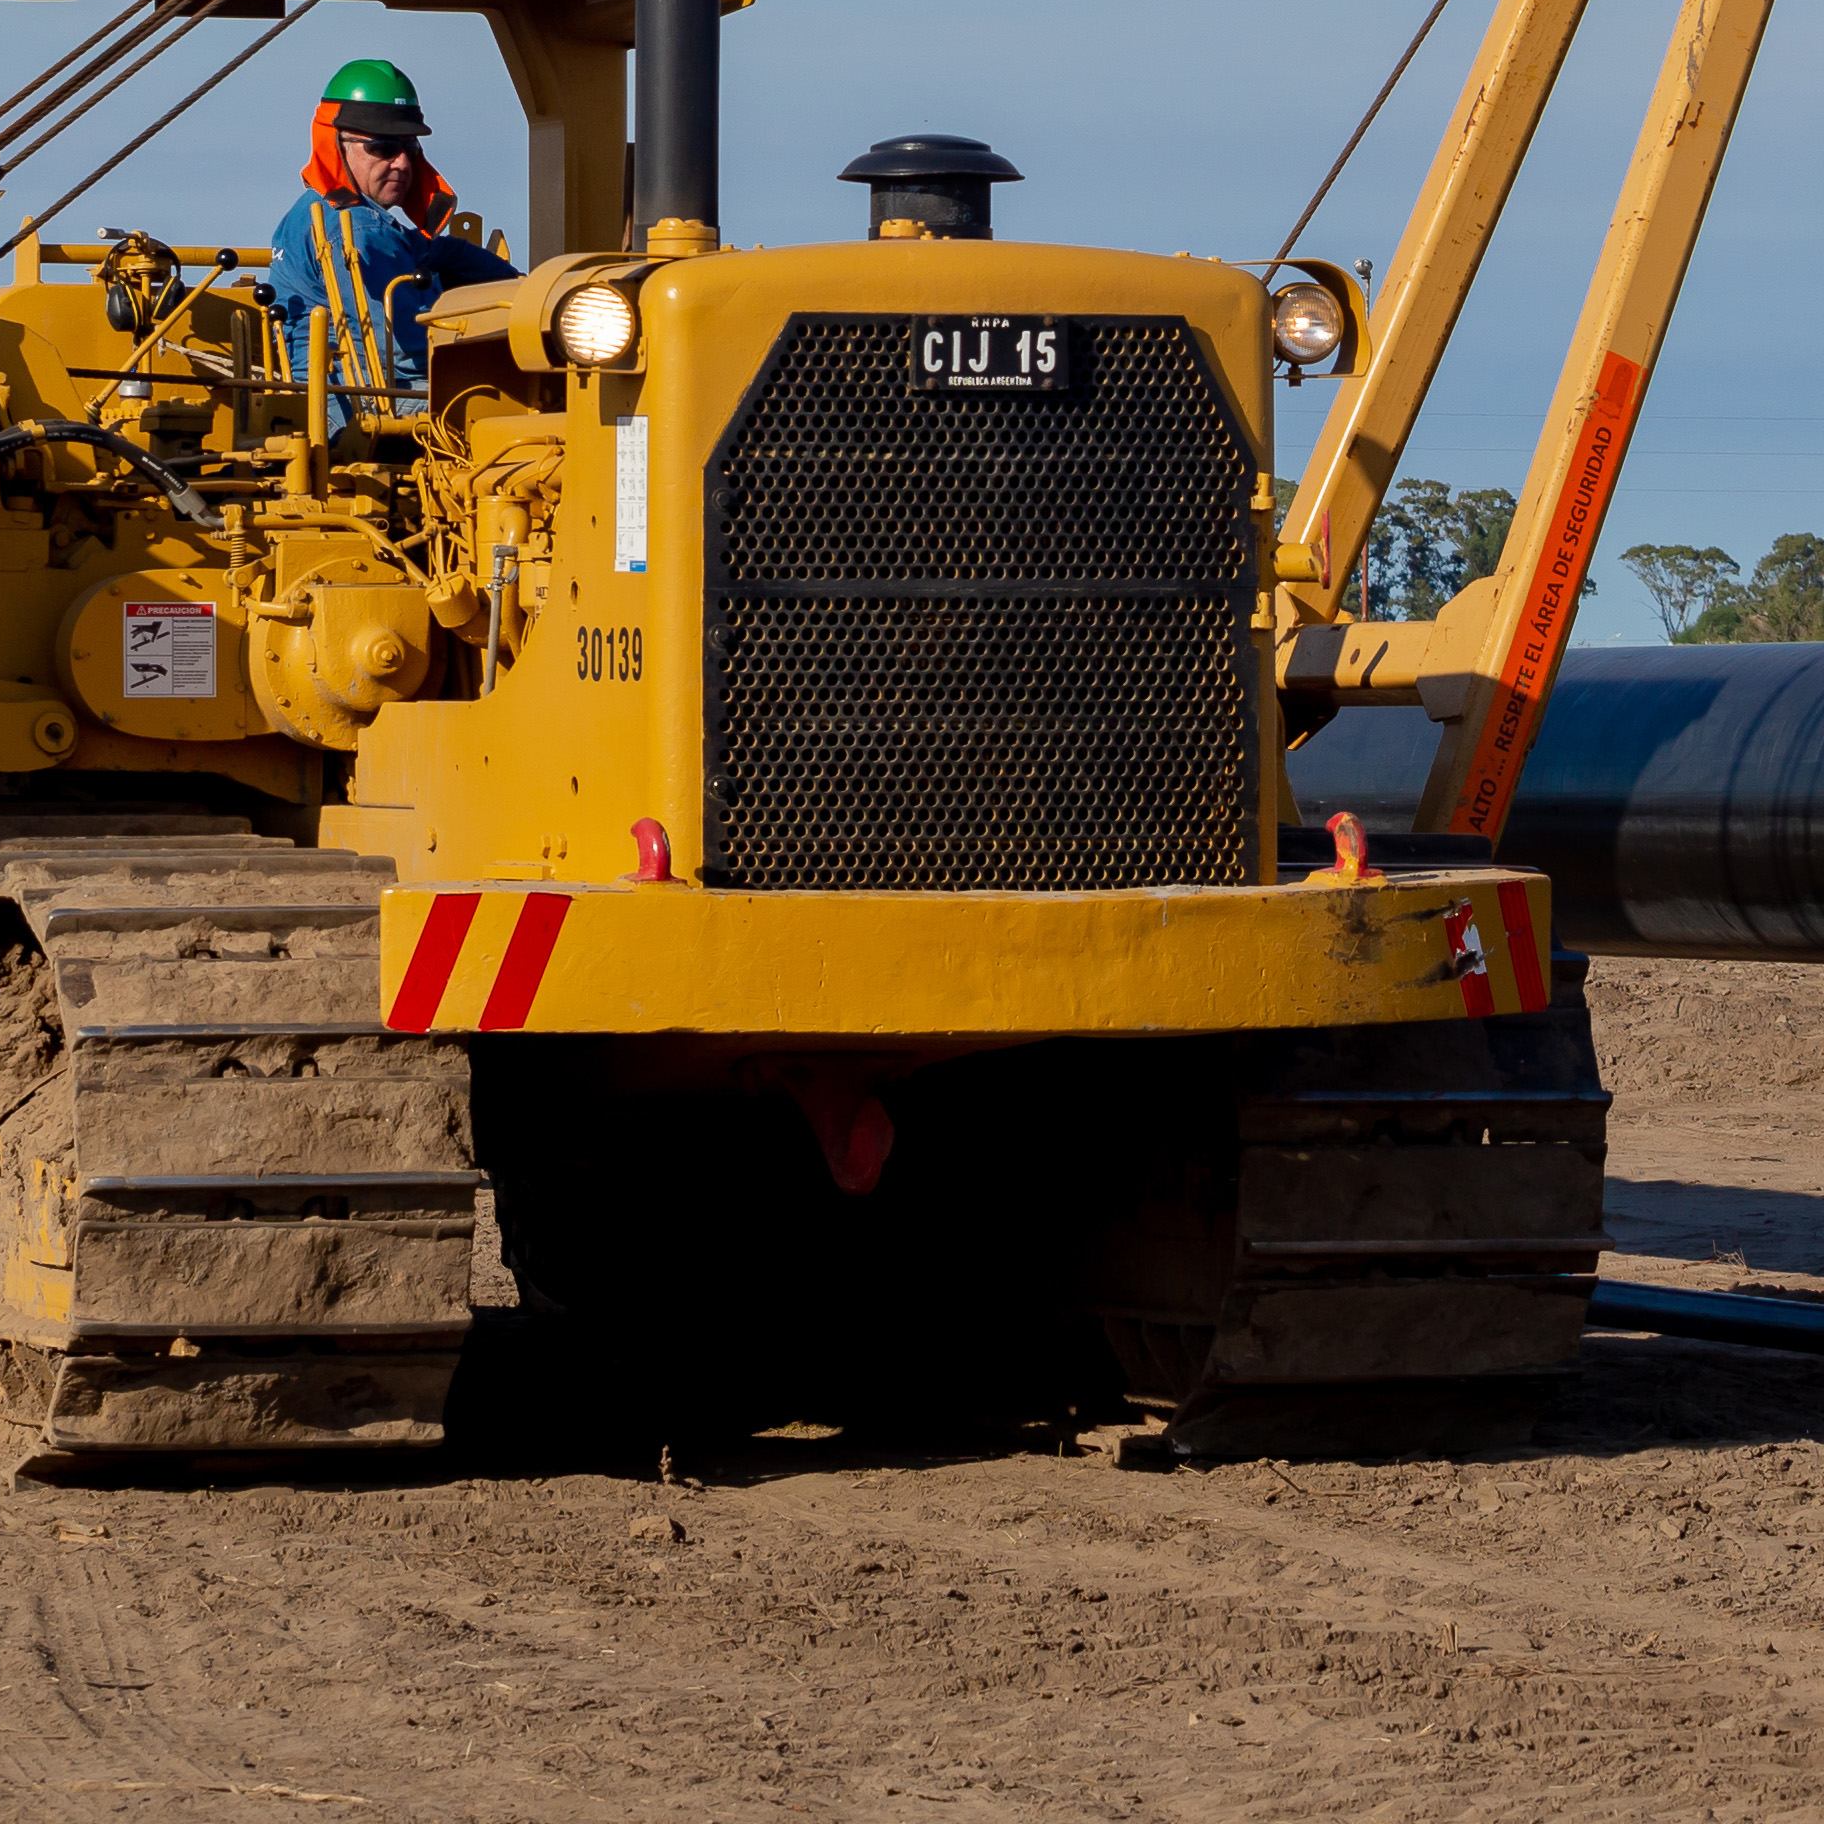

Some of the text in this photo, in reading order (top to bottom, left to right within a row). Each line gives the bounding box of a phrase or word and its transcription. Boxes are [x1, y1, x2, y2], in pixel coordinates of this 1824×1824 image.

[971, 318, 1010, 328] RNPA
[923, 330, 1056, 373] CIJ 15
[948, 375, 1032, 386] REPUBLICA ARGENTINA
[1563, 426, 1613, 547] SEGURIDAD
[1552, 549, 1576, 579] DE
[147, 607, 202, 615] PRECAUCION
[1531, 582, 1565, 640] ÁREA
[576, 625, 644, 683] 30139
[1522, 641, 1545, 666] EL
[1495, 664, 1535, 753] RESPETE
[1468, 778, 1497, 832] ALTO
